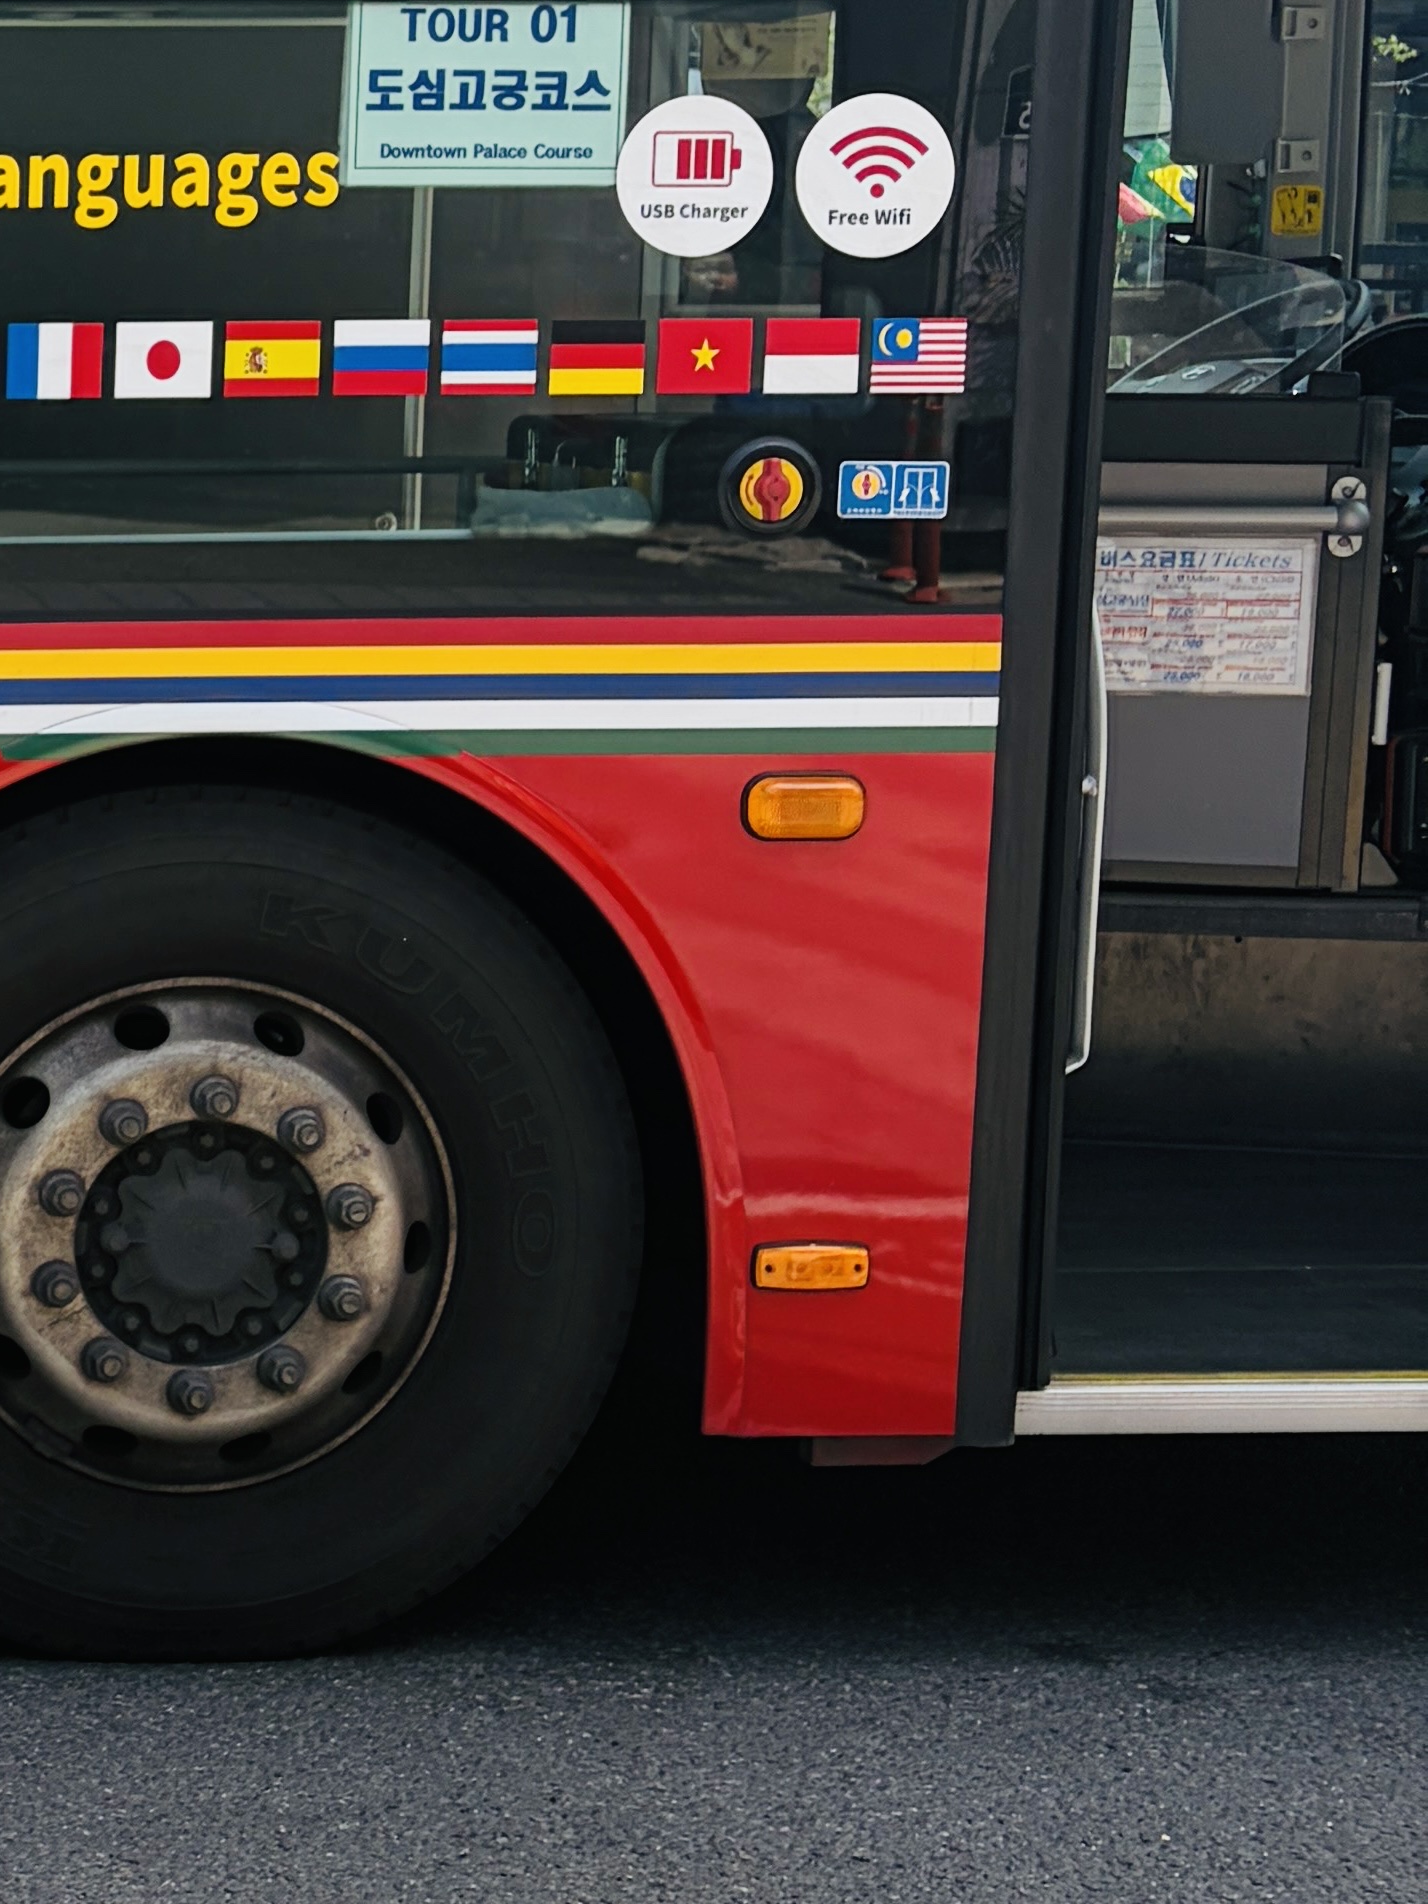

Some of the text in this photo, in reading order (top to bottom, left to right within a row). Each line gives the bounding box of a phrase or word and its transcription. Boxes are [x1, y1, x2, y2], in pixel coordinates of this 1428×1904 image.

[400, 4, 578, 43] TOUR 01
[364, 68, 613, 112] 도심고궁코스
[379, 142, 593, 160] Downtown Palace Course
[640, 203, 749, 223] USB Charger
[827, 207, 912, 226] Free Wifi
[1210, 552, 1293, 569] Tickets
[256, 887, 560, 1281] KUMHO
